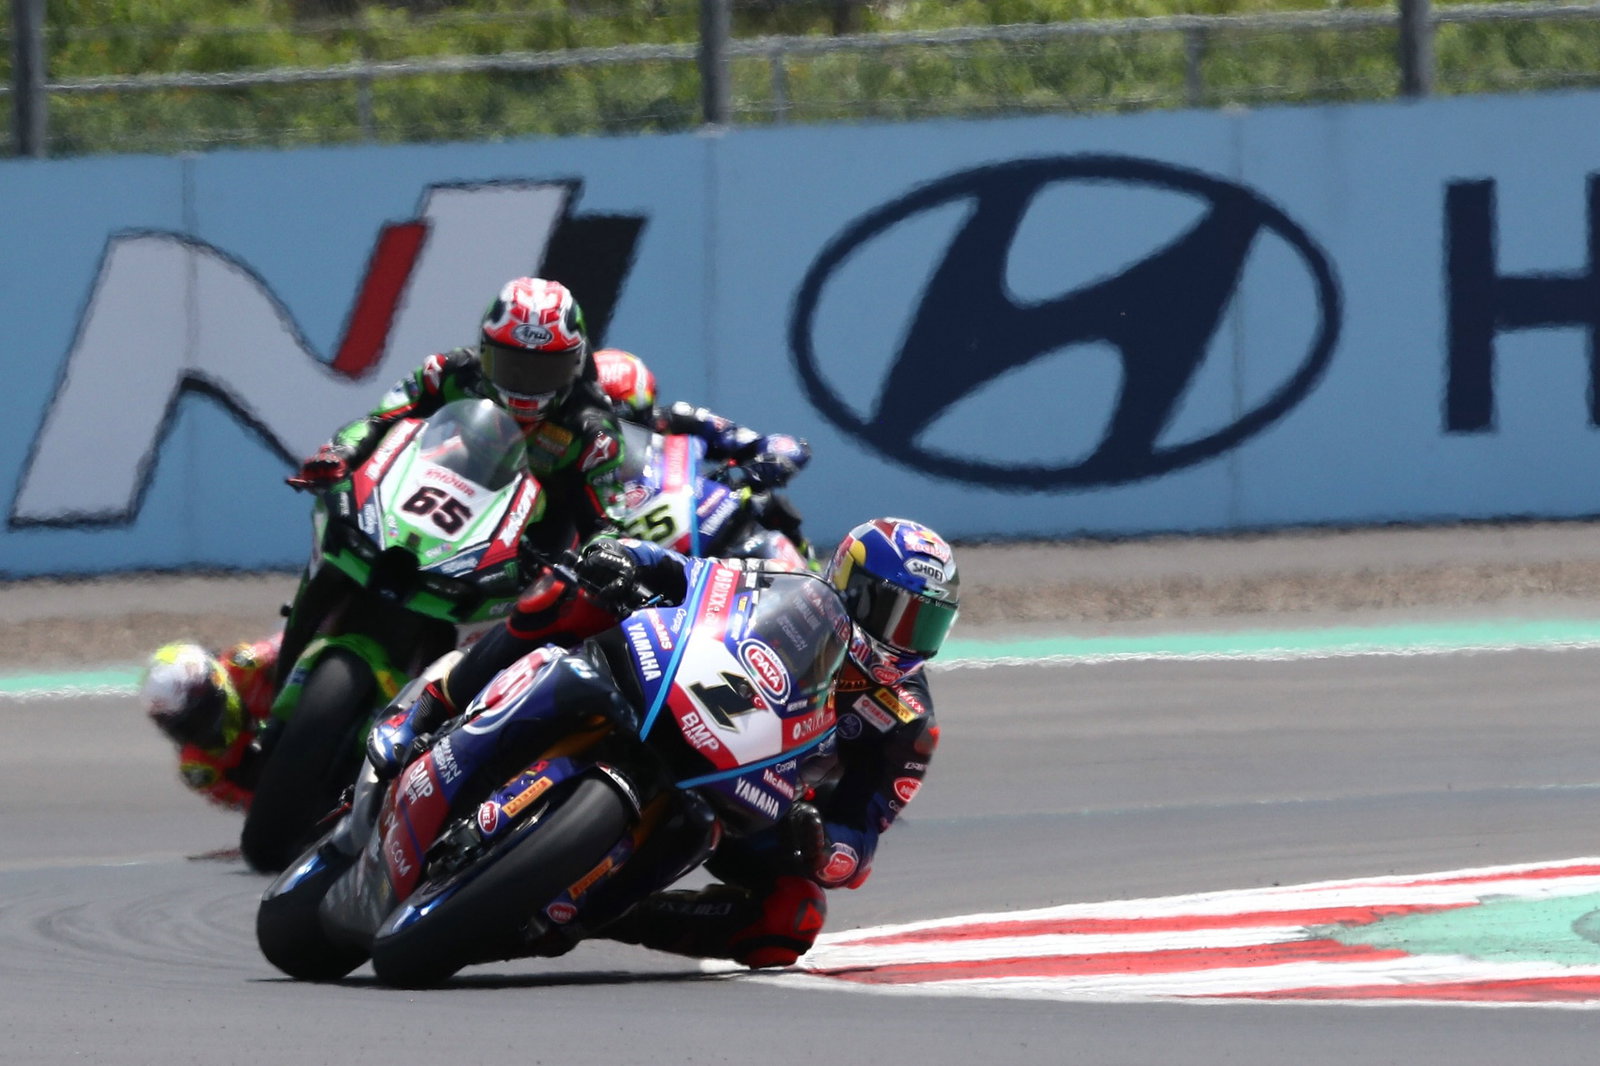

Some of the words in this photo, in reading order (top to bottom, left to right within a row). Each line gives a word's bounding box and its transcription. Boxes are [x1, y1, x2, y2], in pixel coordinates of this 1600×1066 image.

[402, 486, 474, 535] 65
[913, 562, 943, 582] SHOEI
[627, 622, 662, 681] YAMAHA
[751, 651, 781, 689] PATA
[681, 711, 719, 750] BMP
[410, 761, 433, 798] BMP
[763, 769, 795, 800] McAMS
[775, 758, 797, 773] Corpay
[735, 777, 780, 820] YAMAHA
